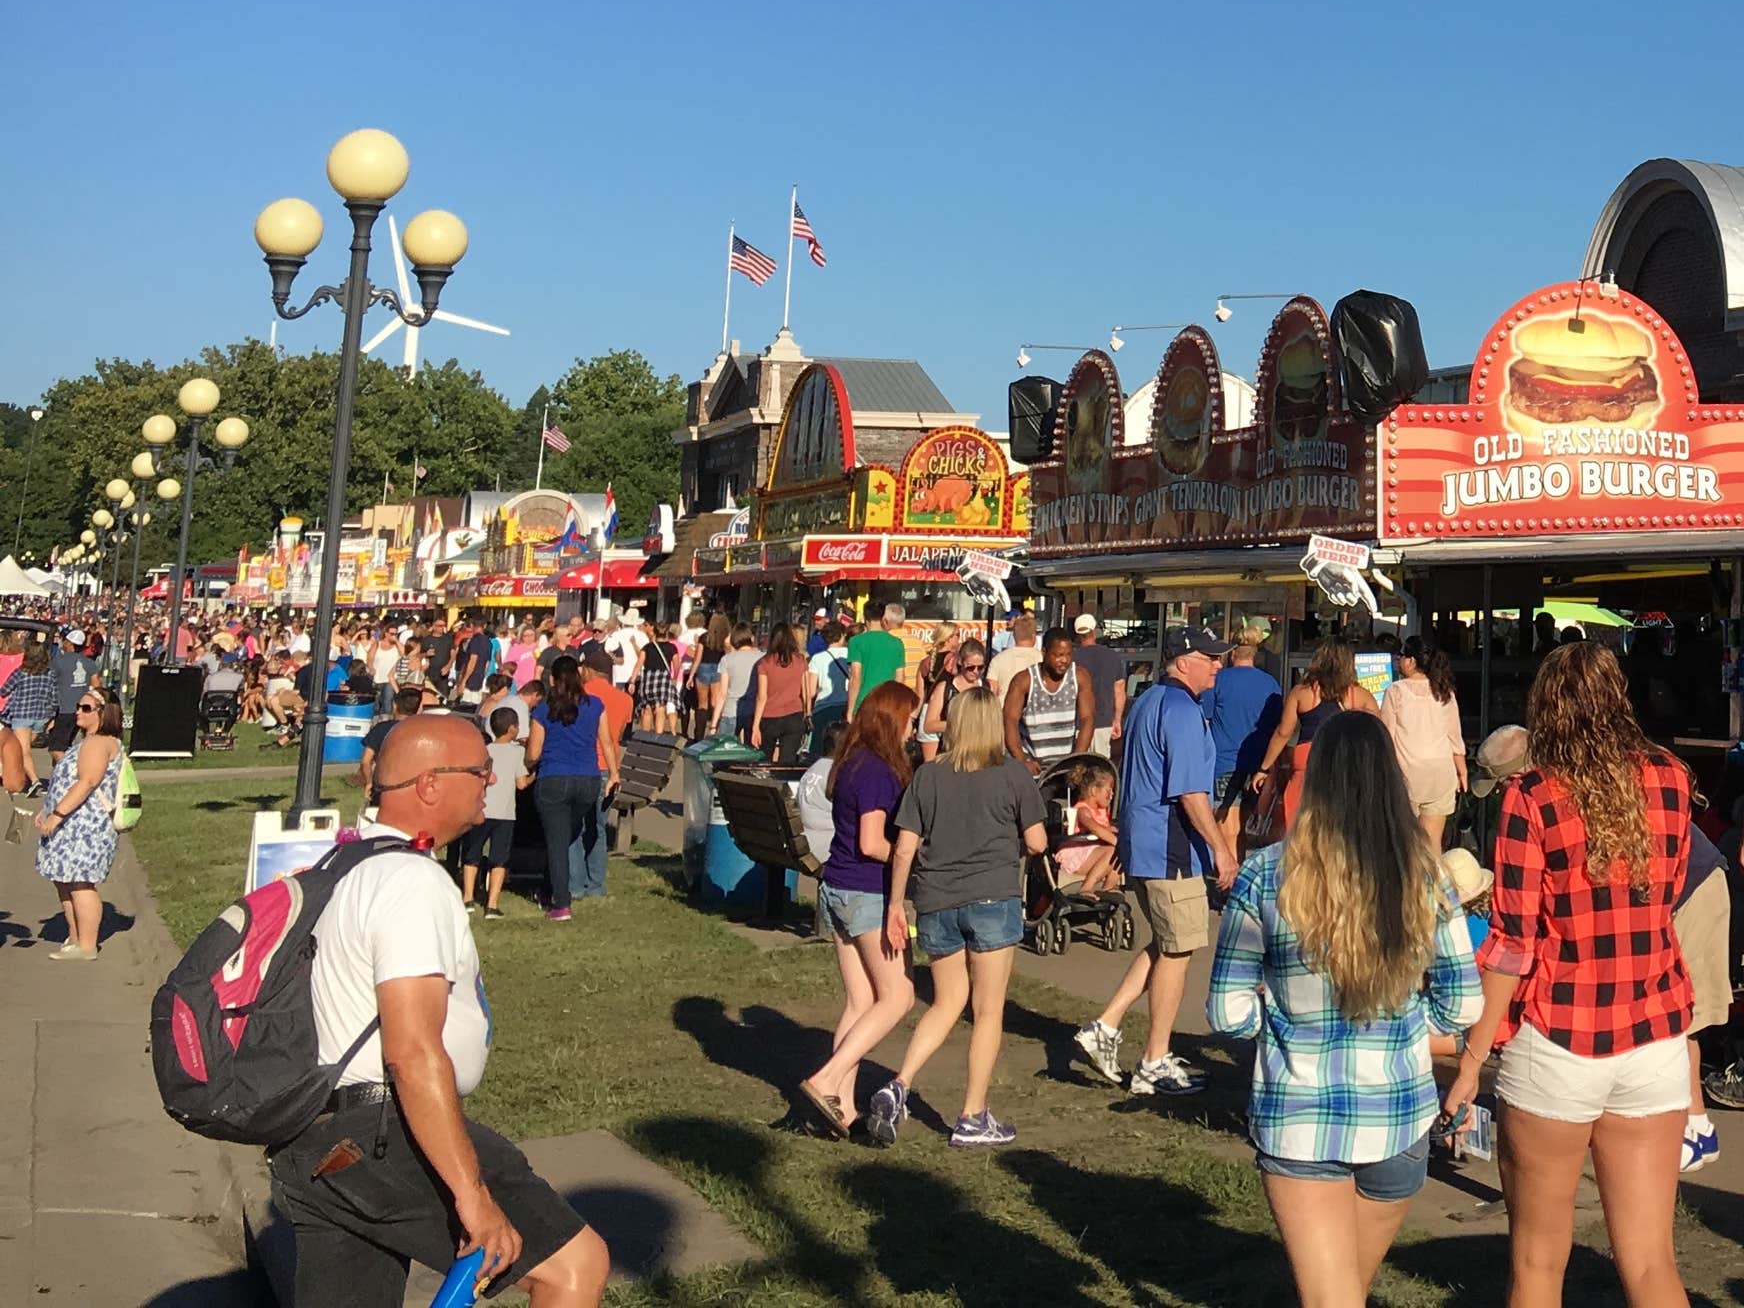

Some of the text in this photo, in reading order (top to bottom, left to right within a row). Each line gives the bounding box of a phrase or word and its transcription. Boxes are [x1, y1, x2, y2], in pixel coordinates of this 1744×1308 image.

[934, 440, 986, 460] PIGS &
[1474, 429, 1690, 464] OLD FASHIONED
[928, 456, 986, 476] CHICKS
[1243, 474, 1362, 525] JUMBO BURGER
[1442, 461, 1723, 517] JUMBO BURGER
[1134, 480, 1242, 524] GIANT TENDERLOIN
[1033, 491, 1130, 536] CHICKEN STRIPS
[817, 541, 869, 562] Coca-Cola
[1313, 537, 1367, 558] ORDER
[1316, 549, 1360, 567] HERE
[968, 552, 1010, 570] ORDER
[968, 562, 1003, 577] HERE
